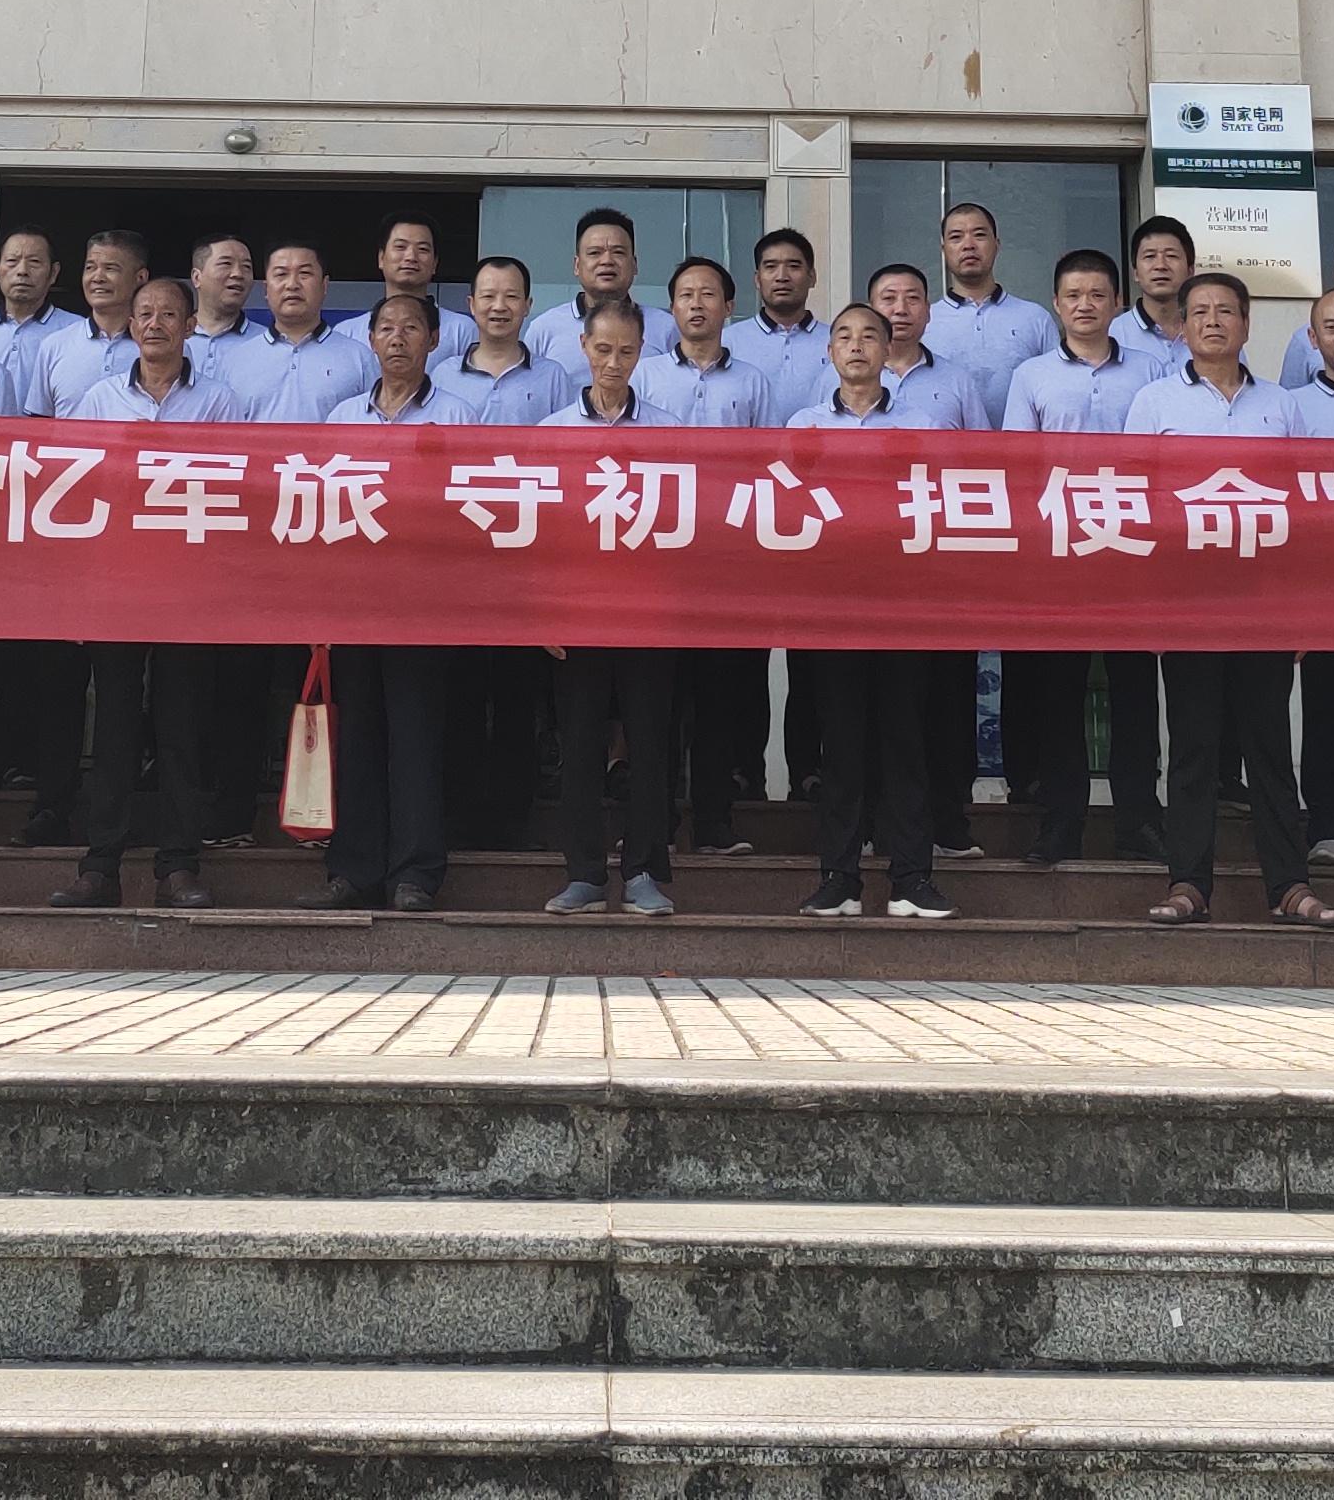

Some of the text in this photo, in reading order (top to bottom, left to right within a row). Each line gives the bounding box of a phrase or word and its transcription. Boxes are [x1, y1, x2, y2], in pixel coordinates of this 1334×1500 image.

[1221, 106, 1284, 122] 国家电网
[1206, 206, 1268, 223] 营业时间
[1236, 258, 1292, 268] 8:30-17:00
[444, 454, 844, 551] 守初心
